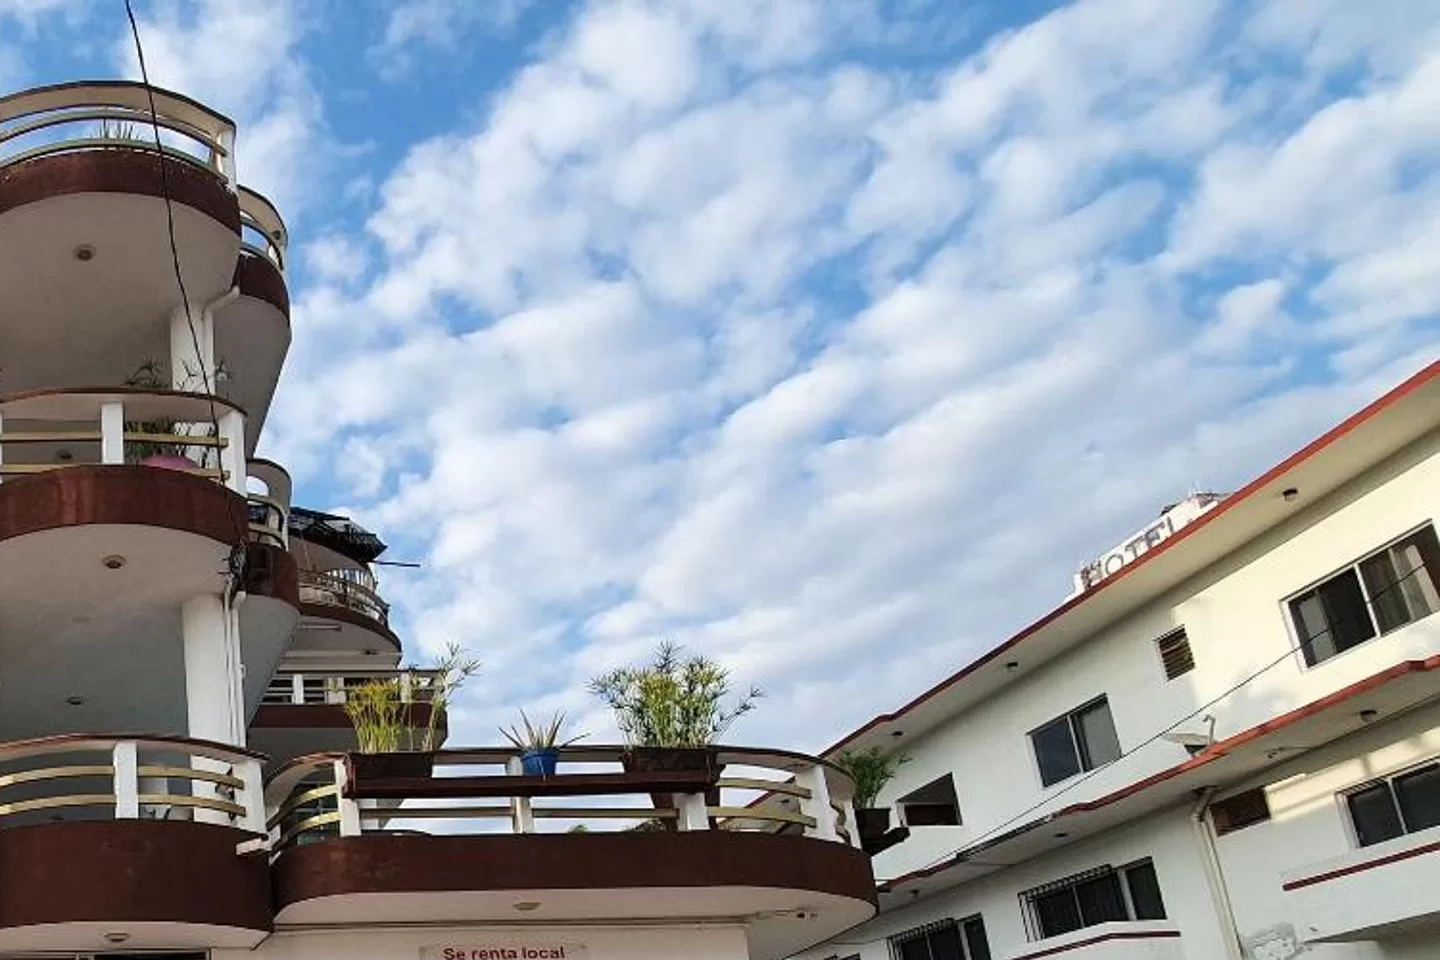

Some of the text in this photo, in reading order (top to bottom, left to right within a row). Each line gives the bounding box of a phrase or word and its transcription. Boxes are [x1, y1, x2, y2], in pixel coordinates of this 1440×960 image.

[443, 946, 565, 960] Se renta local
